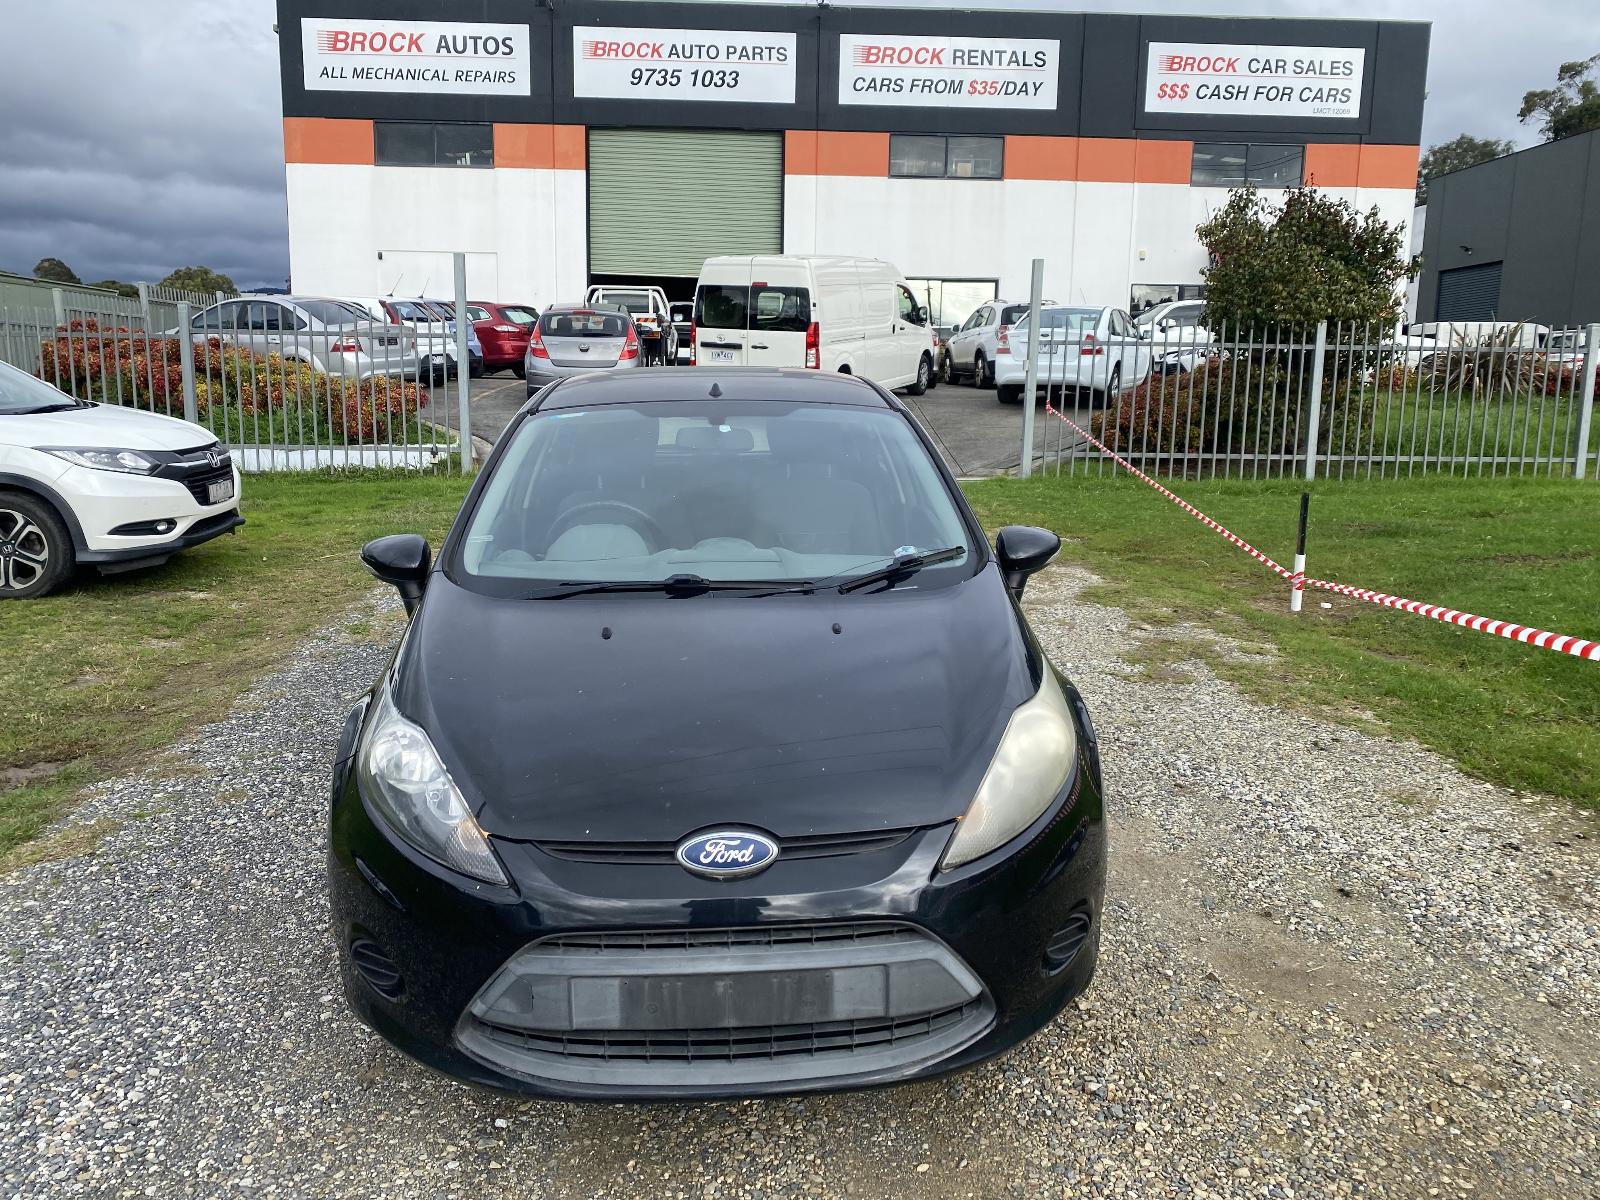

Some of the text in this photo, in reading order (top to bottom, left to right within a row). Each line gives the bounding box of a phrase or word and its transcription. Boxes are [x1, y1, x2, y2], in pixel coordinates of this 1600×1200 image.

[330, 30, 514, 56] BROCK AUTOS
[592, 40, 788, 62] BROCK AUTO PARTS
[864, 45, 1047, 68] BROCK RENTALS
[1168, 55, 1354, 76] BROCK CAR SALES
[319, 66, 516, 84] ALL MECHANICAL REPAIRS
[630, 67, 740, 88] 9735 1033
[852, 76, 1044, 97] CARS FROM $35/DAY
[1157, 82, 1352, 104] $$$ CASH FOR CARS
[699, 839, 755, 864] Ford
